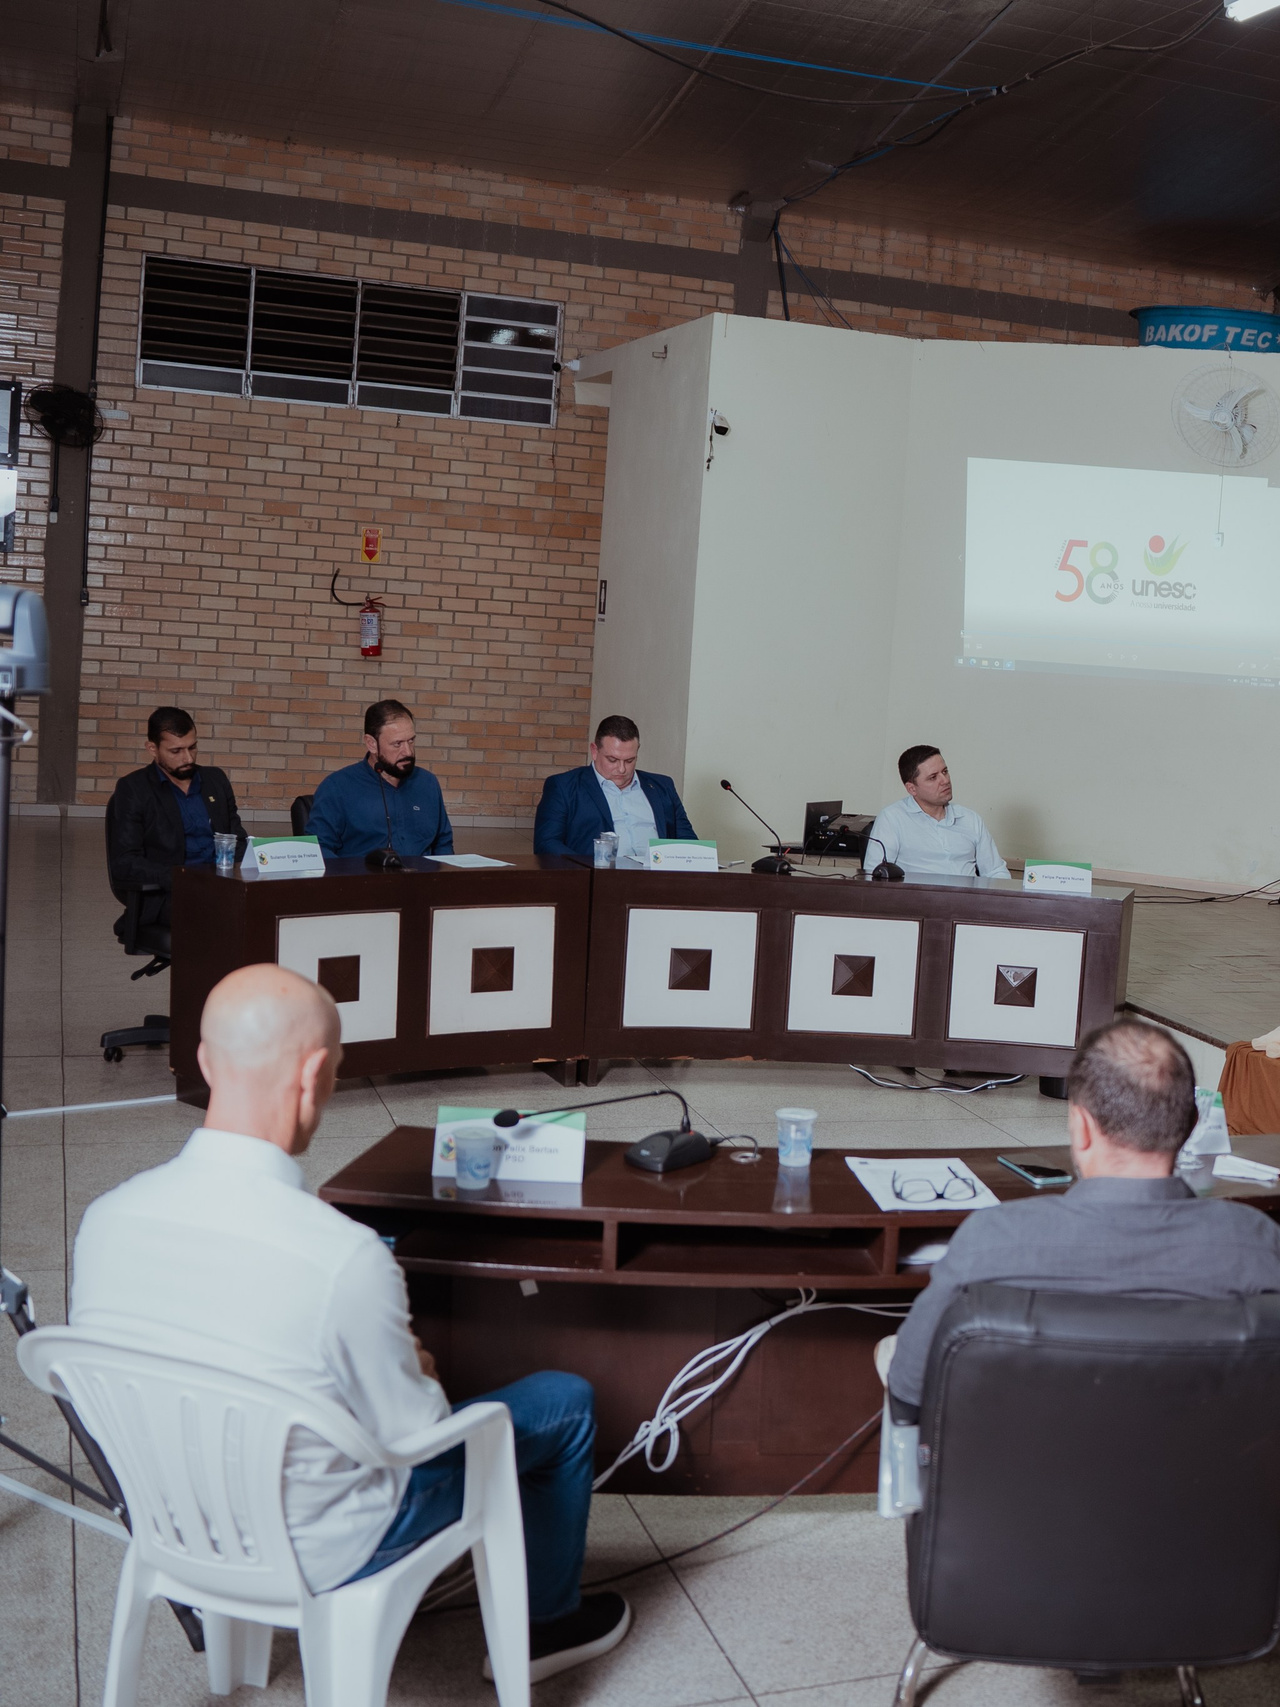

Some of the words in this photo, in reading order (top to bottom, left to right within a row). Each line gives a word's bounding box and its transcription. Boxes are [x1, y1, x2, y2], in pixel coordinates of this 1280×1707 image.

[1145, 324, 1219, 343] BAKOF
[1225, 325, 1273, 348] TEC
[1055, 539, 1119, 605] 58
[1100, 582, 1124, 591] ANOS
[1132, 579, 1196, 600] unesc
[1153, 602, 1196, 612] universidade
[505, 1154, 524, 1162] PSD
